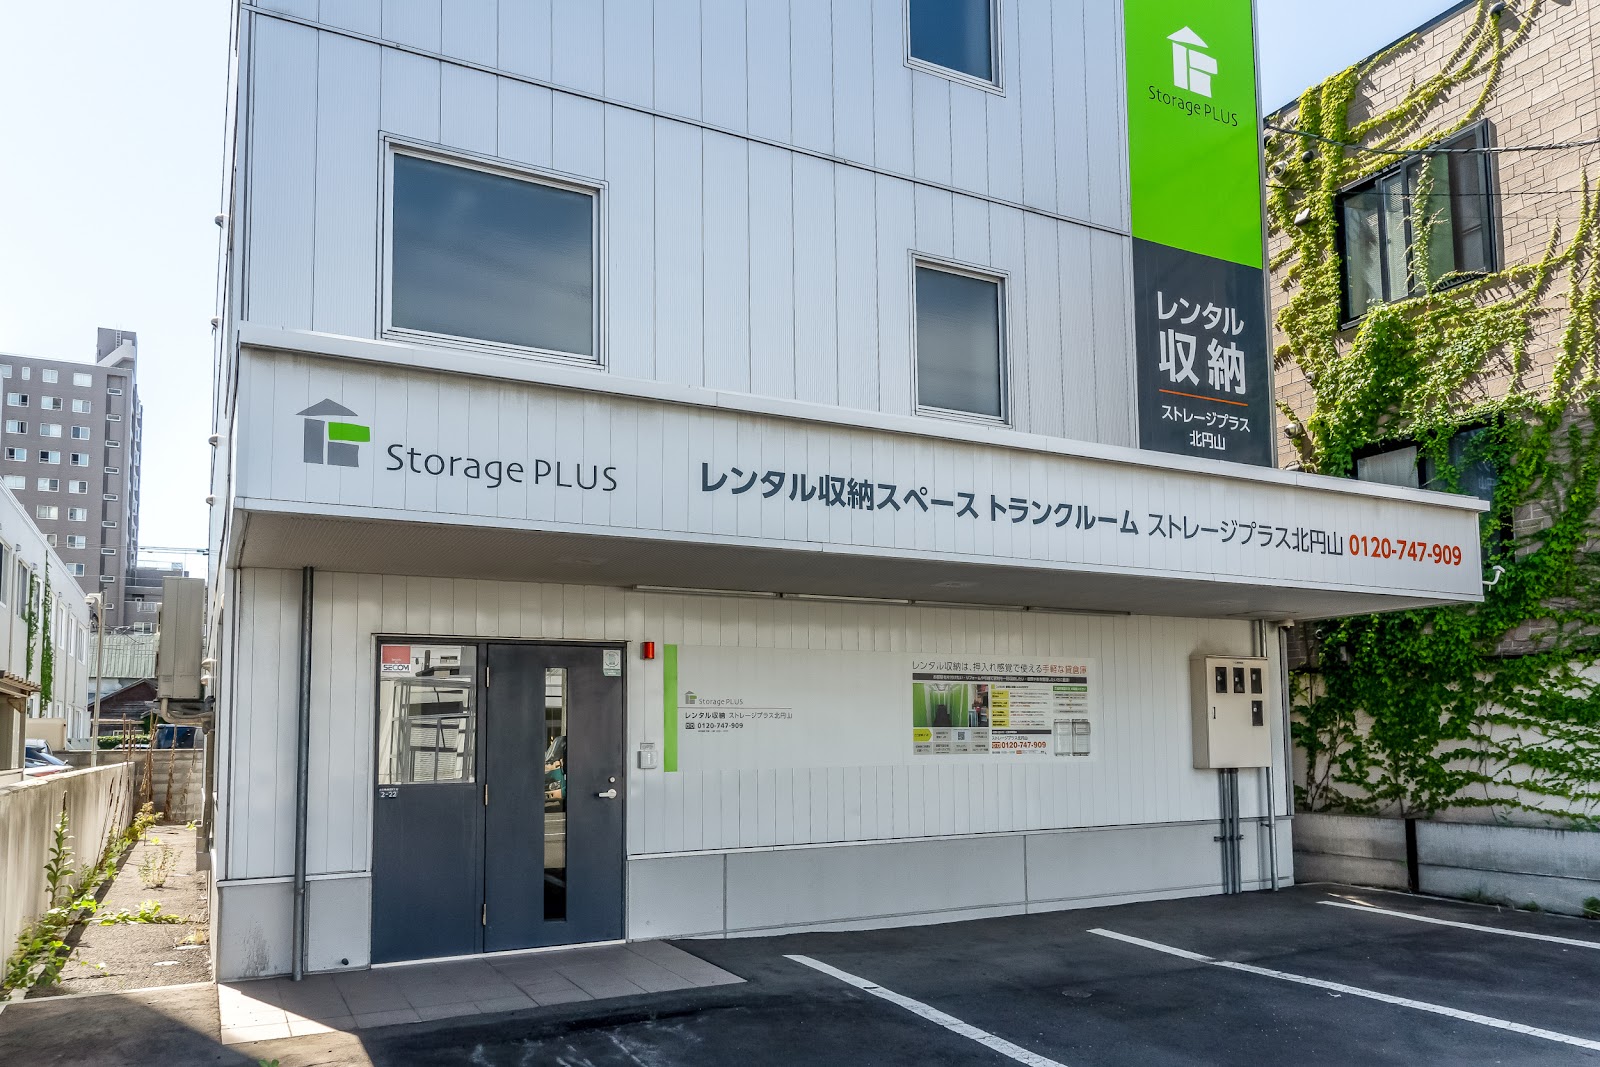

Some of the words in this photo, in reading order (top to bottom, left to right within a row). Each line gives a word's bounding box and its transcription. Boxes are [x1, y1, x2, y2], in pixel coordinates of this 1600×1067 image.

[1148, 85, 1201, 116] Storage
[1204, 103, 1238, 127] PLUS
[1157, 290, 1245, 336] レンタル
[1158, 328, 1247, 395] 収納
[1161, 404, 1251, 433] ストレージプラス
[1189, 429, 1226, 450] 北円山
[386, 443, 524, 489] Storage
[534, 458, 618, 492] PLUS
[701, 462, 980, 520] レンタル収納スペース
[989, 494, 1140, 535] トランクルーム
[1147, 512, 1344, 557] ストレージプラス北円山
[1348, 533, 1462, 567] 0120-747-909
[685, 711, 726, 719] レンタル収納
[728, 711, 793, 720] ストレージプラス北円山
[698, 698, 725, 706] Storage
[1001, 741, 1047, 749] 0120-747-909
